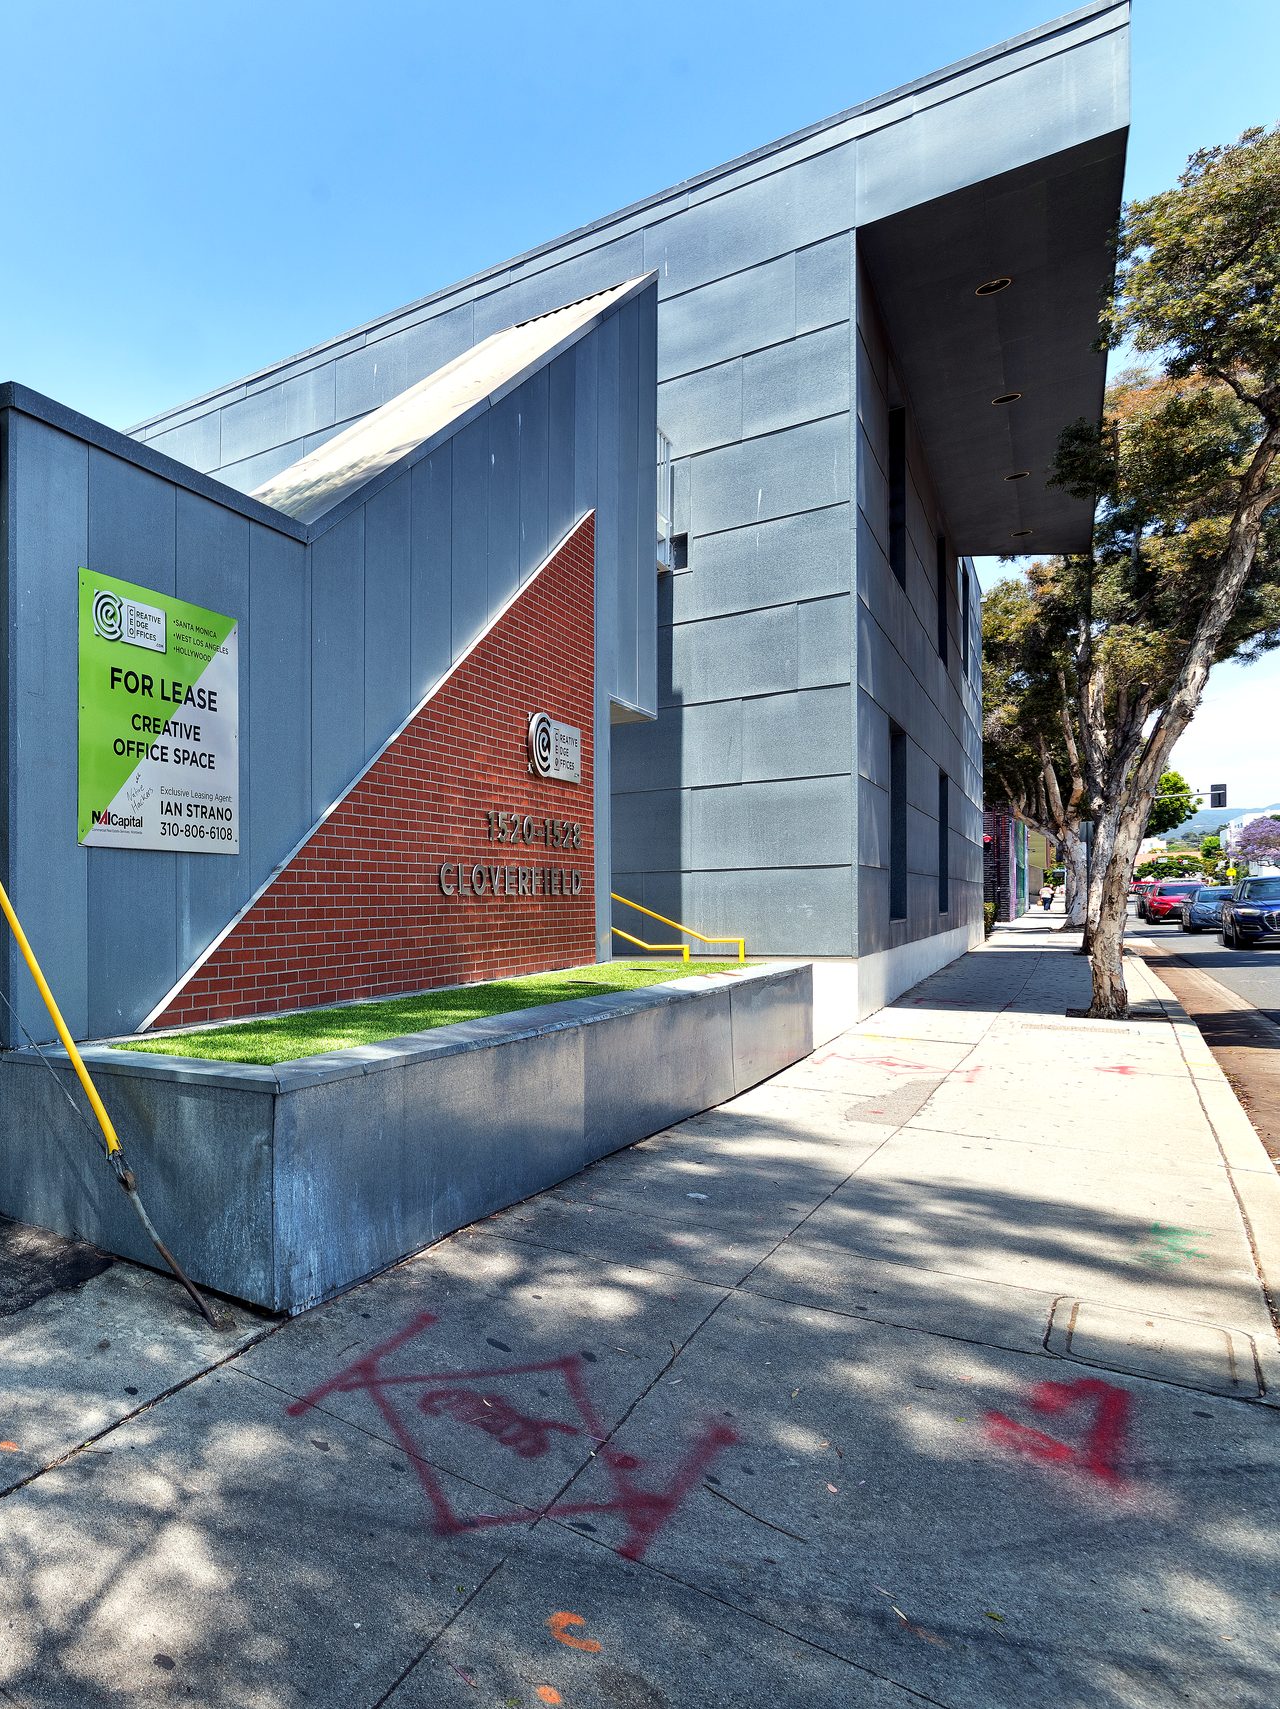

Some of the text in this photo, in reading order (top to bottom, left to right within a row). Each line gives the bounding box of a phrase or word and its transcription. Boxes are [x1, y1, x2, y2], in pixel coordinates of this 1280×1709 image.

[175, 619, 218, 639] SANTA MONICA
[175, 632, 229, 655] WEST LOS ANGELES
[175, 645, 212, 663] HOLLYWOOD
[110, 666, 218, 712] FOR LEASE
[131, 713, 201, 742] CREATIVE
[113, 738, 216, 770] OFFICE SPACE
[160, 786, 190, 798] Exclusive
[190, 789, 214, 802] Leasing
[160, 800, 233, 822] IAN STRANO
[160, 822, 233, 841] 310-806-6108
[487, 811, 582, 849] 1520-1528
[440, 862, 582, 896] CLOVERFIELD
